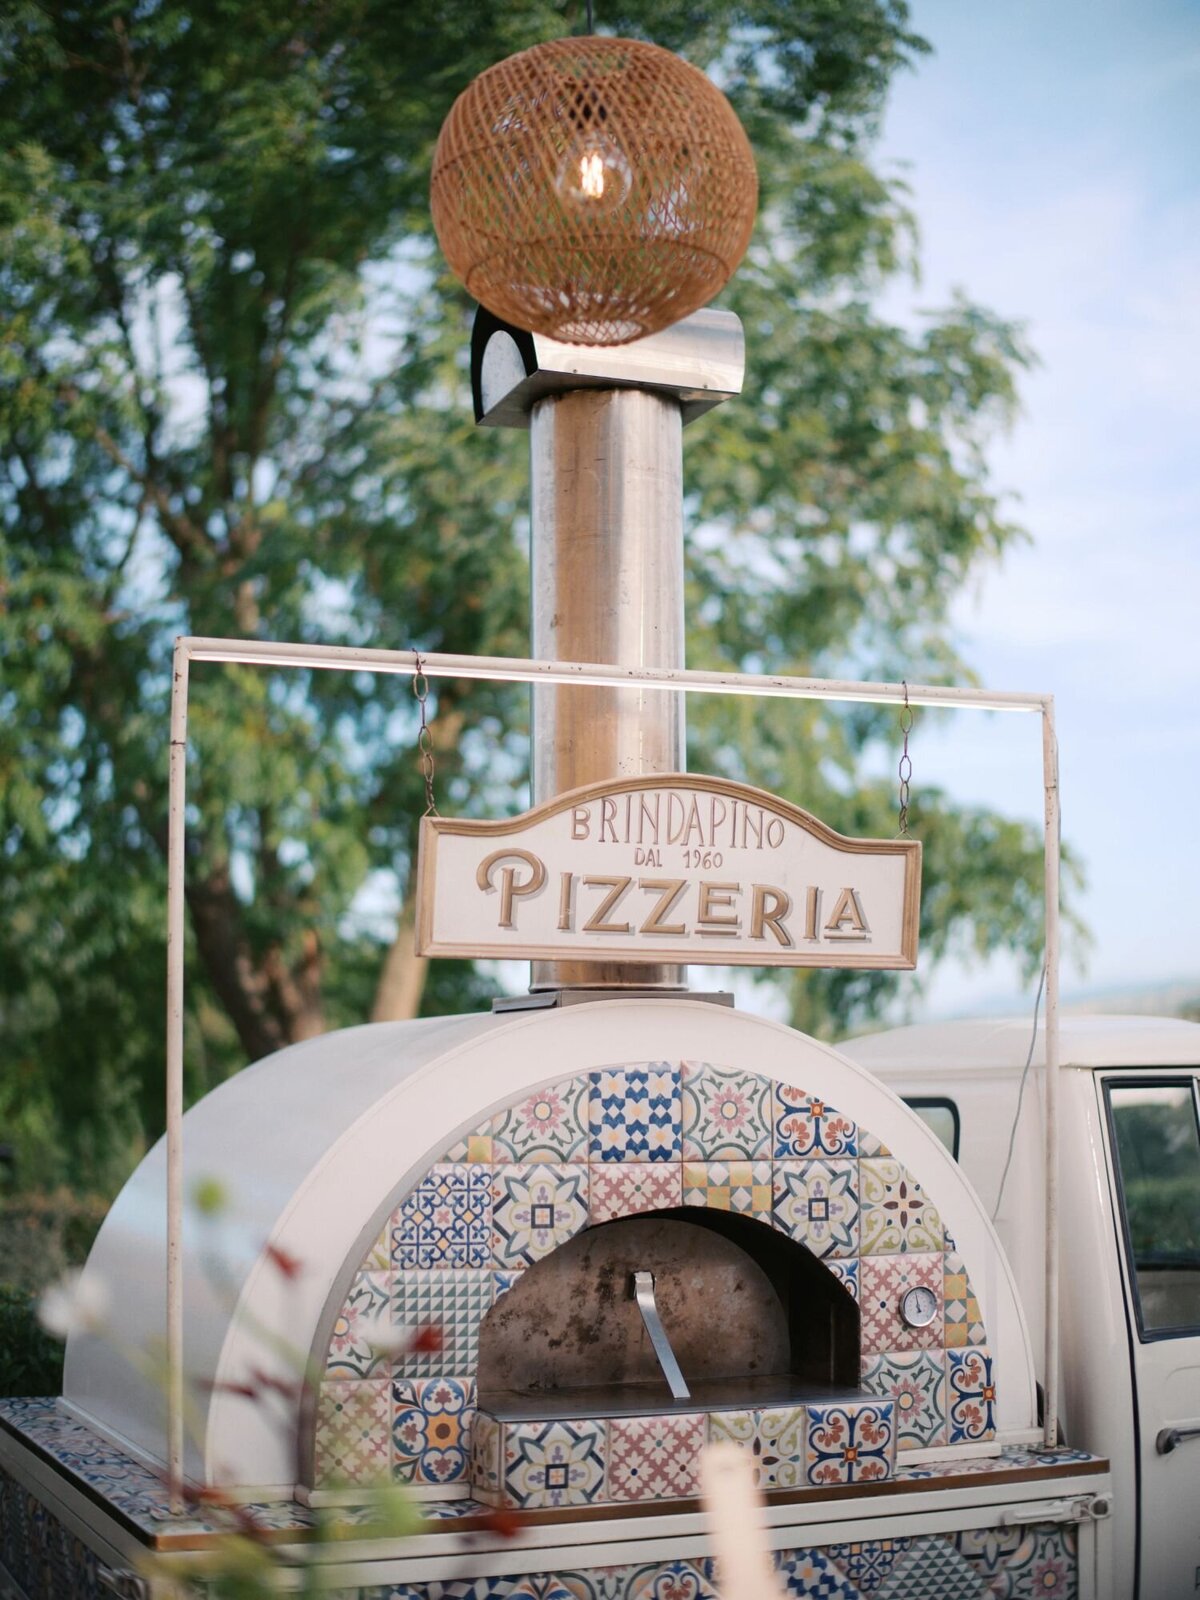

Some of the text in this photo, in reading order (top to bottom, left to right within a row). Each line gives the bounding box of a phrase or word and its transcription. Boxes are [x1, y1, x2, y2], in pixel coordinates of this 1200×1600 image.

[570, 792, 785, 849] BRINDAPINO
[633, 847, 724, 869] DAL 1960
[476, 848, 868, 947] PIZZERIA
